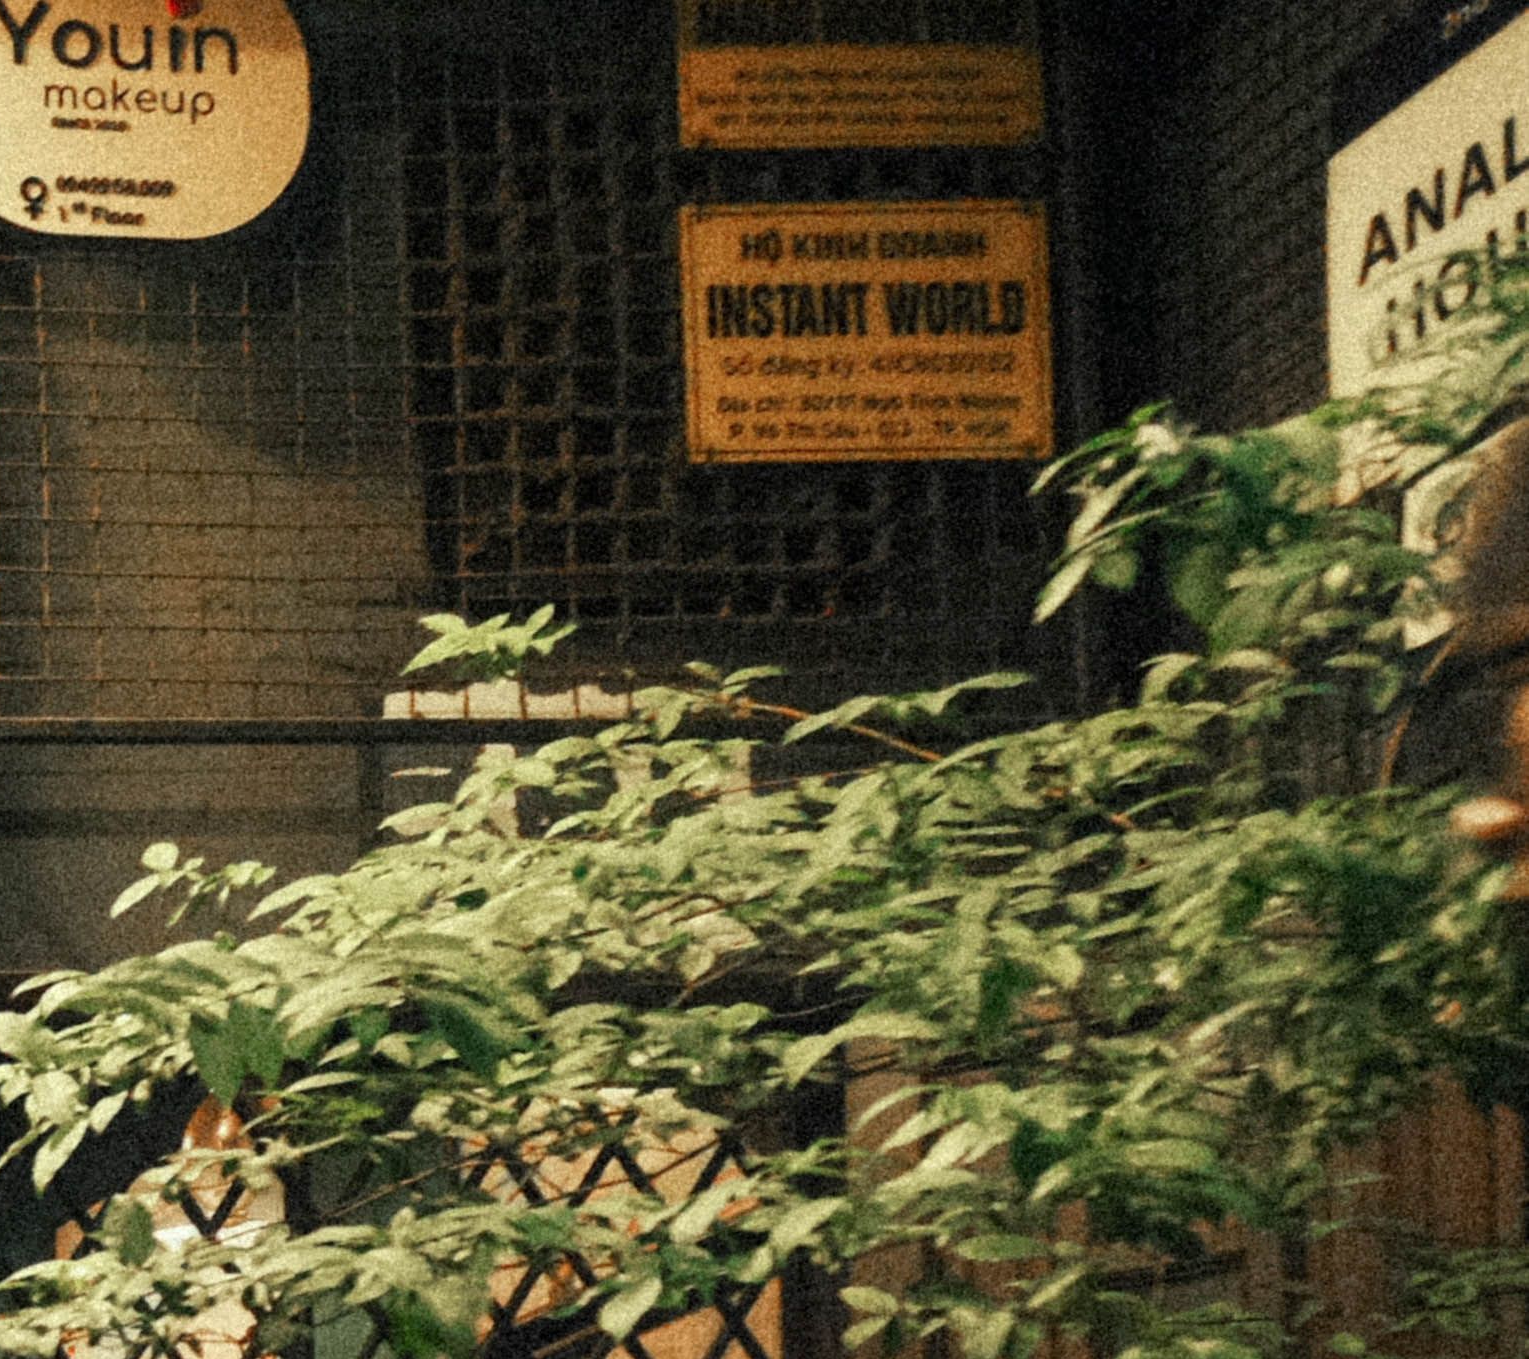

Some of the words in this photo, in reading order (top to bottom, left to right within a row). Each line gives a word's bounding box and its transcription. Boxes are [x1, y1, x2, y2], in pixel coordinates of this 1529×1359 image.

[42, 78, 216, 125] makeup
[706, 282, 869, 339] INSTANT
[881, 279, 1026, 336] WORLD
